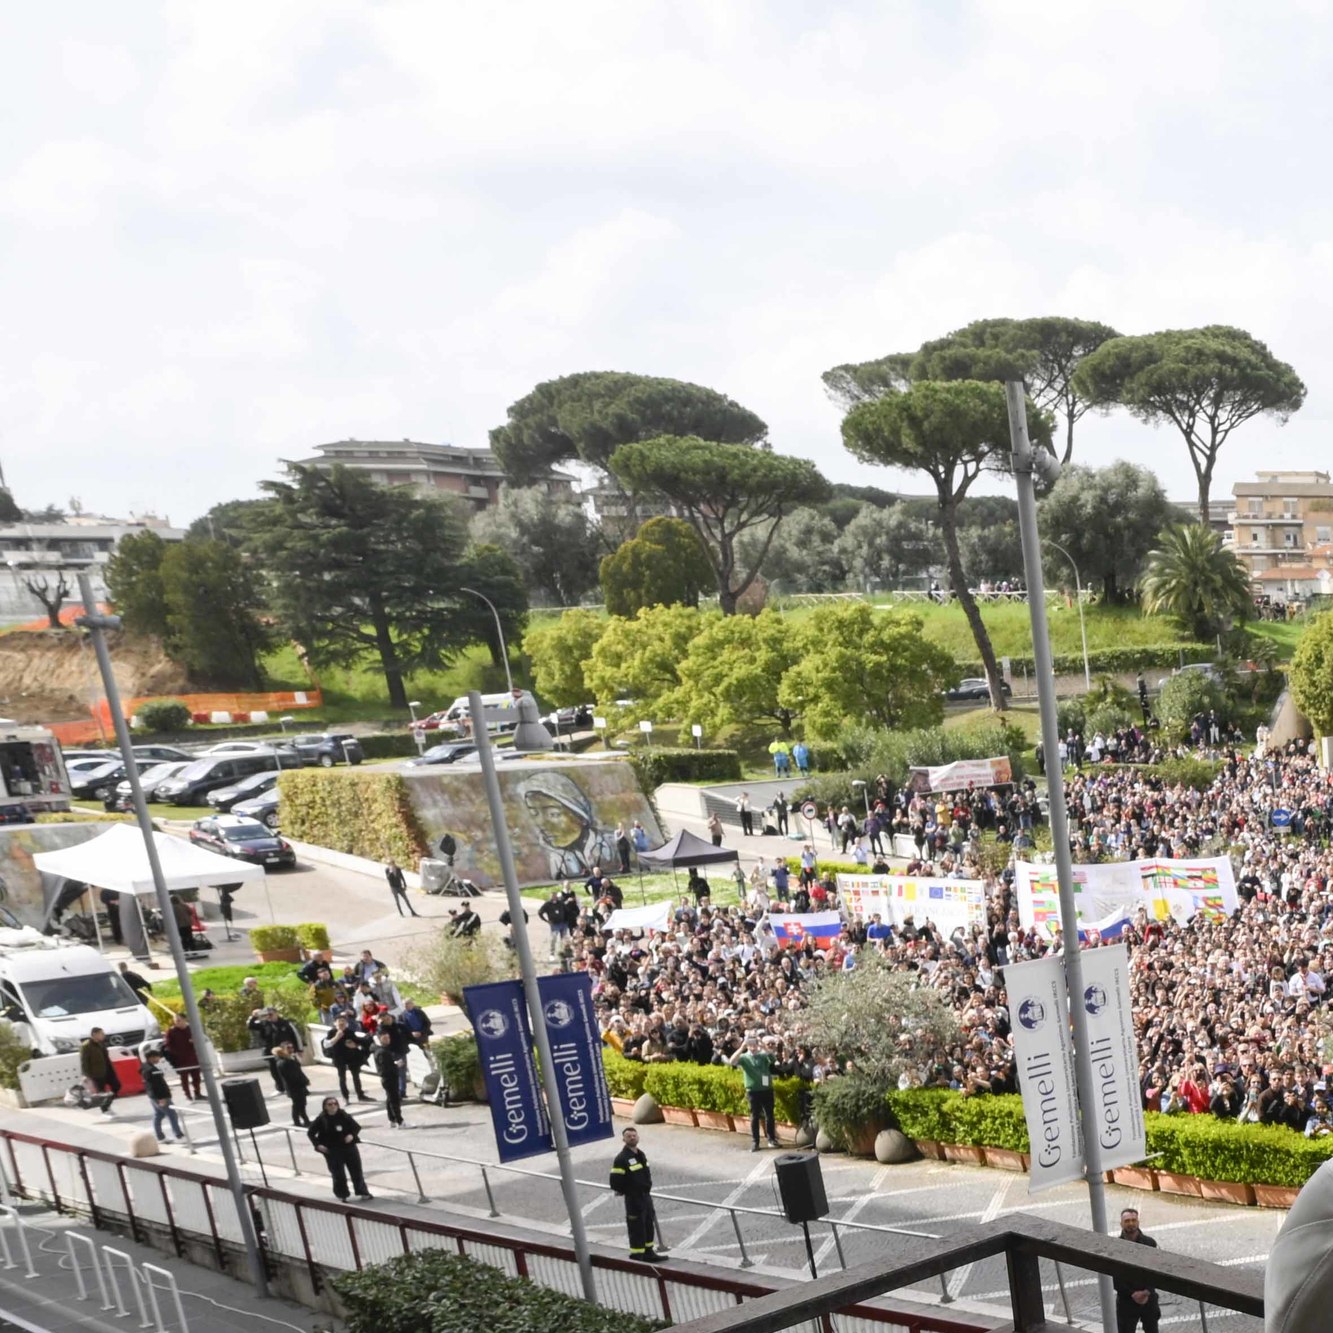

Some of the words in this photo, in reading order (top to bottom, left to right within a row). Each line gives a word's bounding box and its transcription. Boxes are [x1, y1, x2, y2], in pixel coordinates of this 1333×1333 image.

[489, 1052, 528, 1144] Gemelli
[552, 1042, 589, 1131] Gemelli
[1027, 1052, 1061, 1168] Gemelli
[1091, 1037, 1122, 1150] Gemelli
